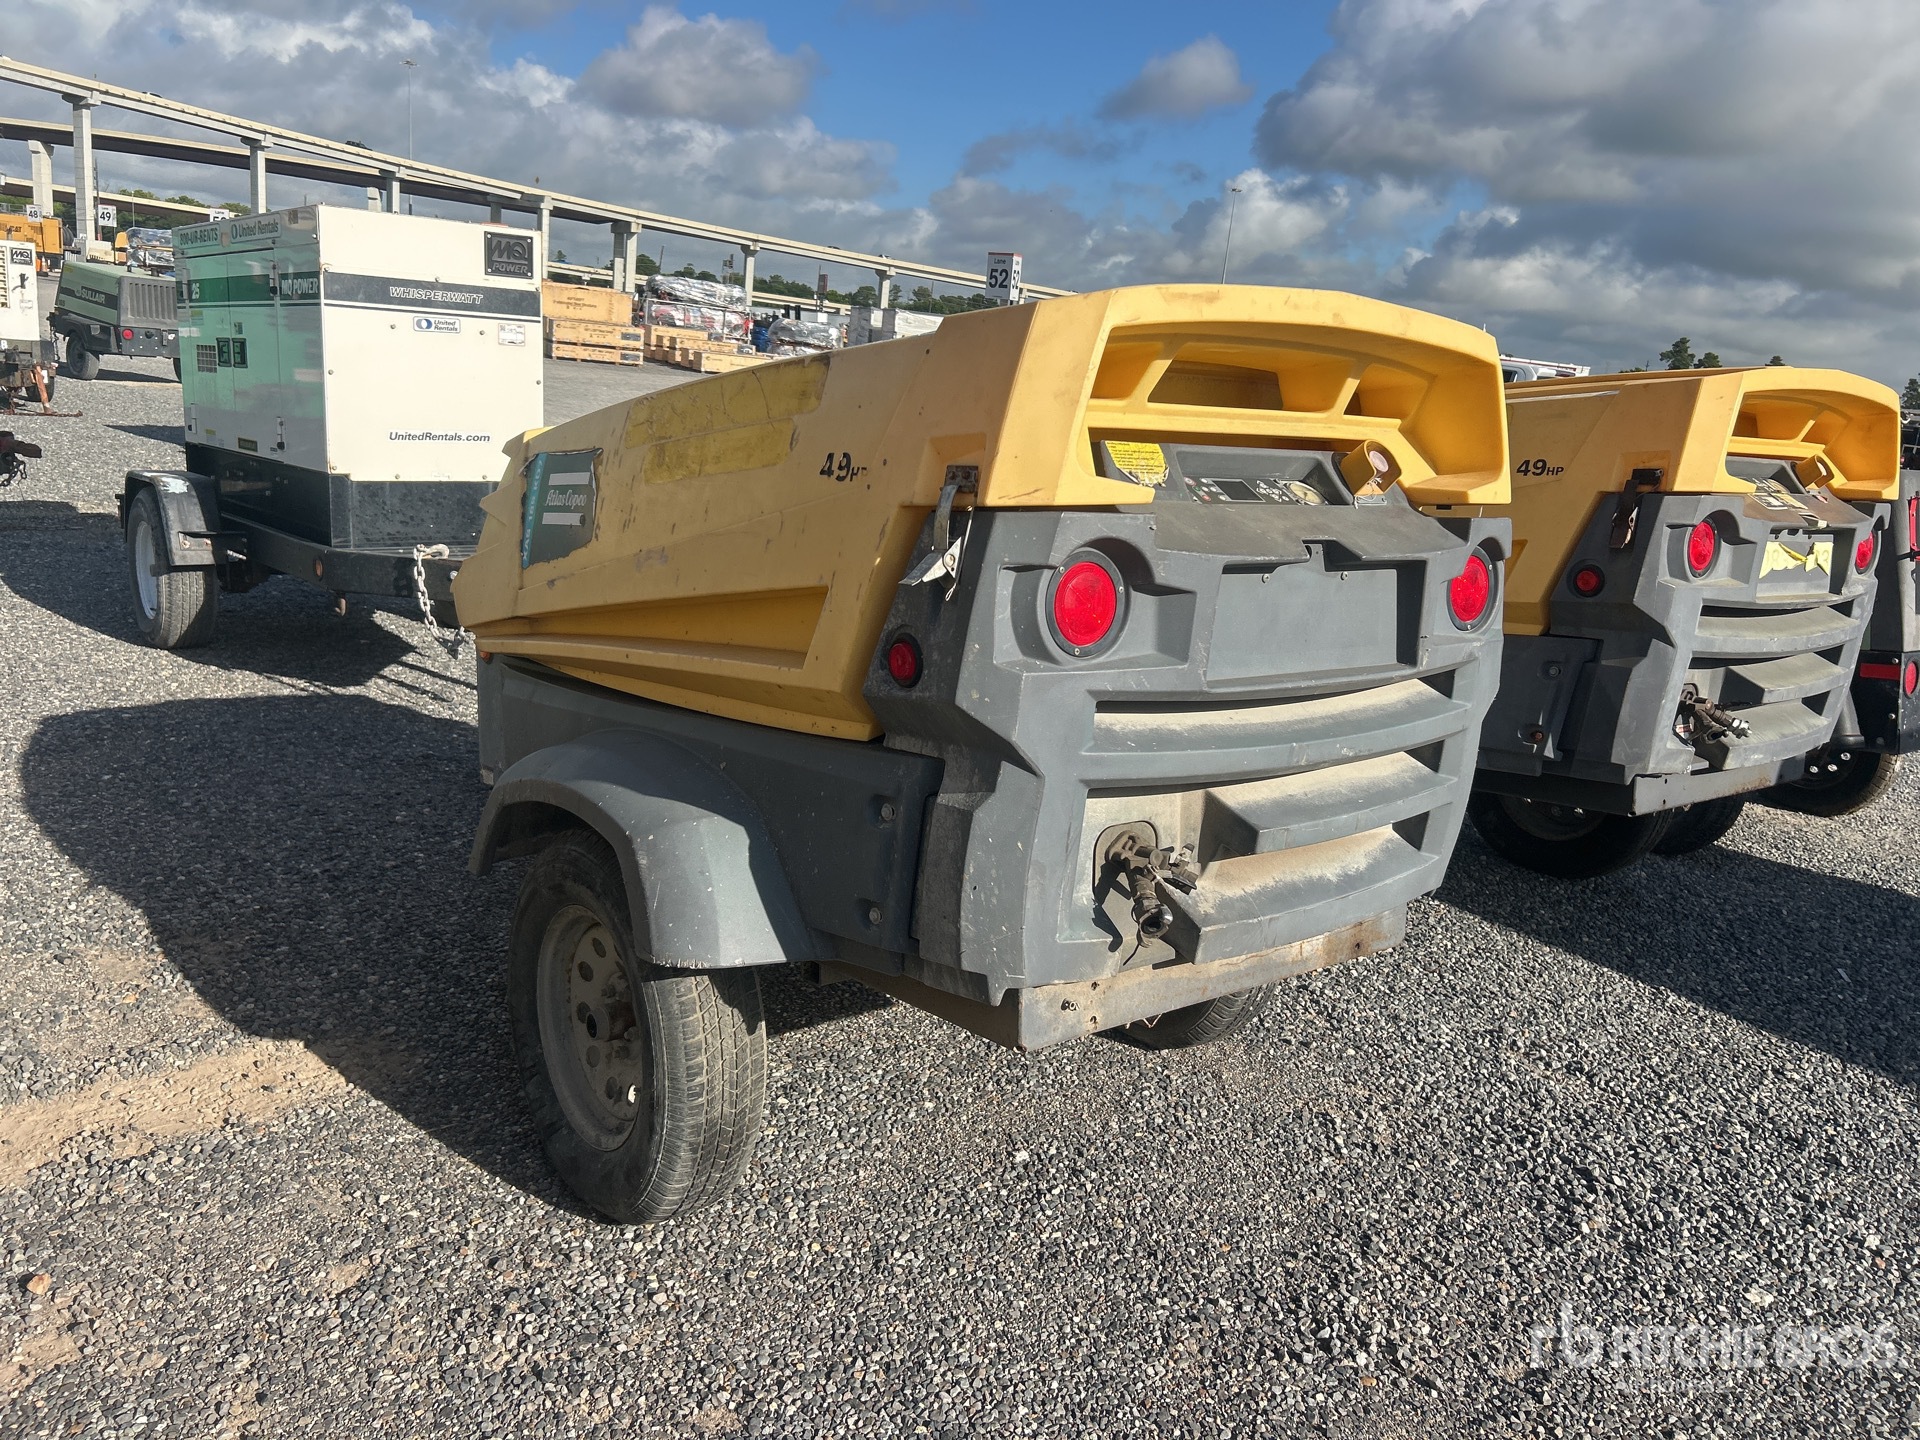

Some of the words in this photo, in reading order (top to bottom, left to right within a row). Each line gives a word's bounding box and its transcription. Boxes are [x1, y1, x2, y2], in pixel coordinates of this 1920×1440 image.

[28, 210, 38, 219] 48
[100, 211, 111, 221] 49
[238, 222, 256, 238] United
[258, 219, 279, 235] Rentals
[13, 250, 30, 259] MQ
[491, 240, 528, 260] MQ
[492, 263, 528, 274] POWER
[988, 268, 1009, 289] 52
[281, 279, 293, 296] MQ
[293, 277, 319, 295] POWER
[81, 288, 106, 304] SULLAIR
[390, 286, 484, 304] WHISPERWATT
[433, 319, 456, 327] United
[389, 431, 491, 442] UnitedRentals.com
